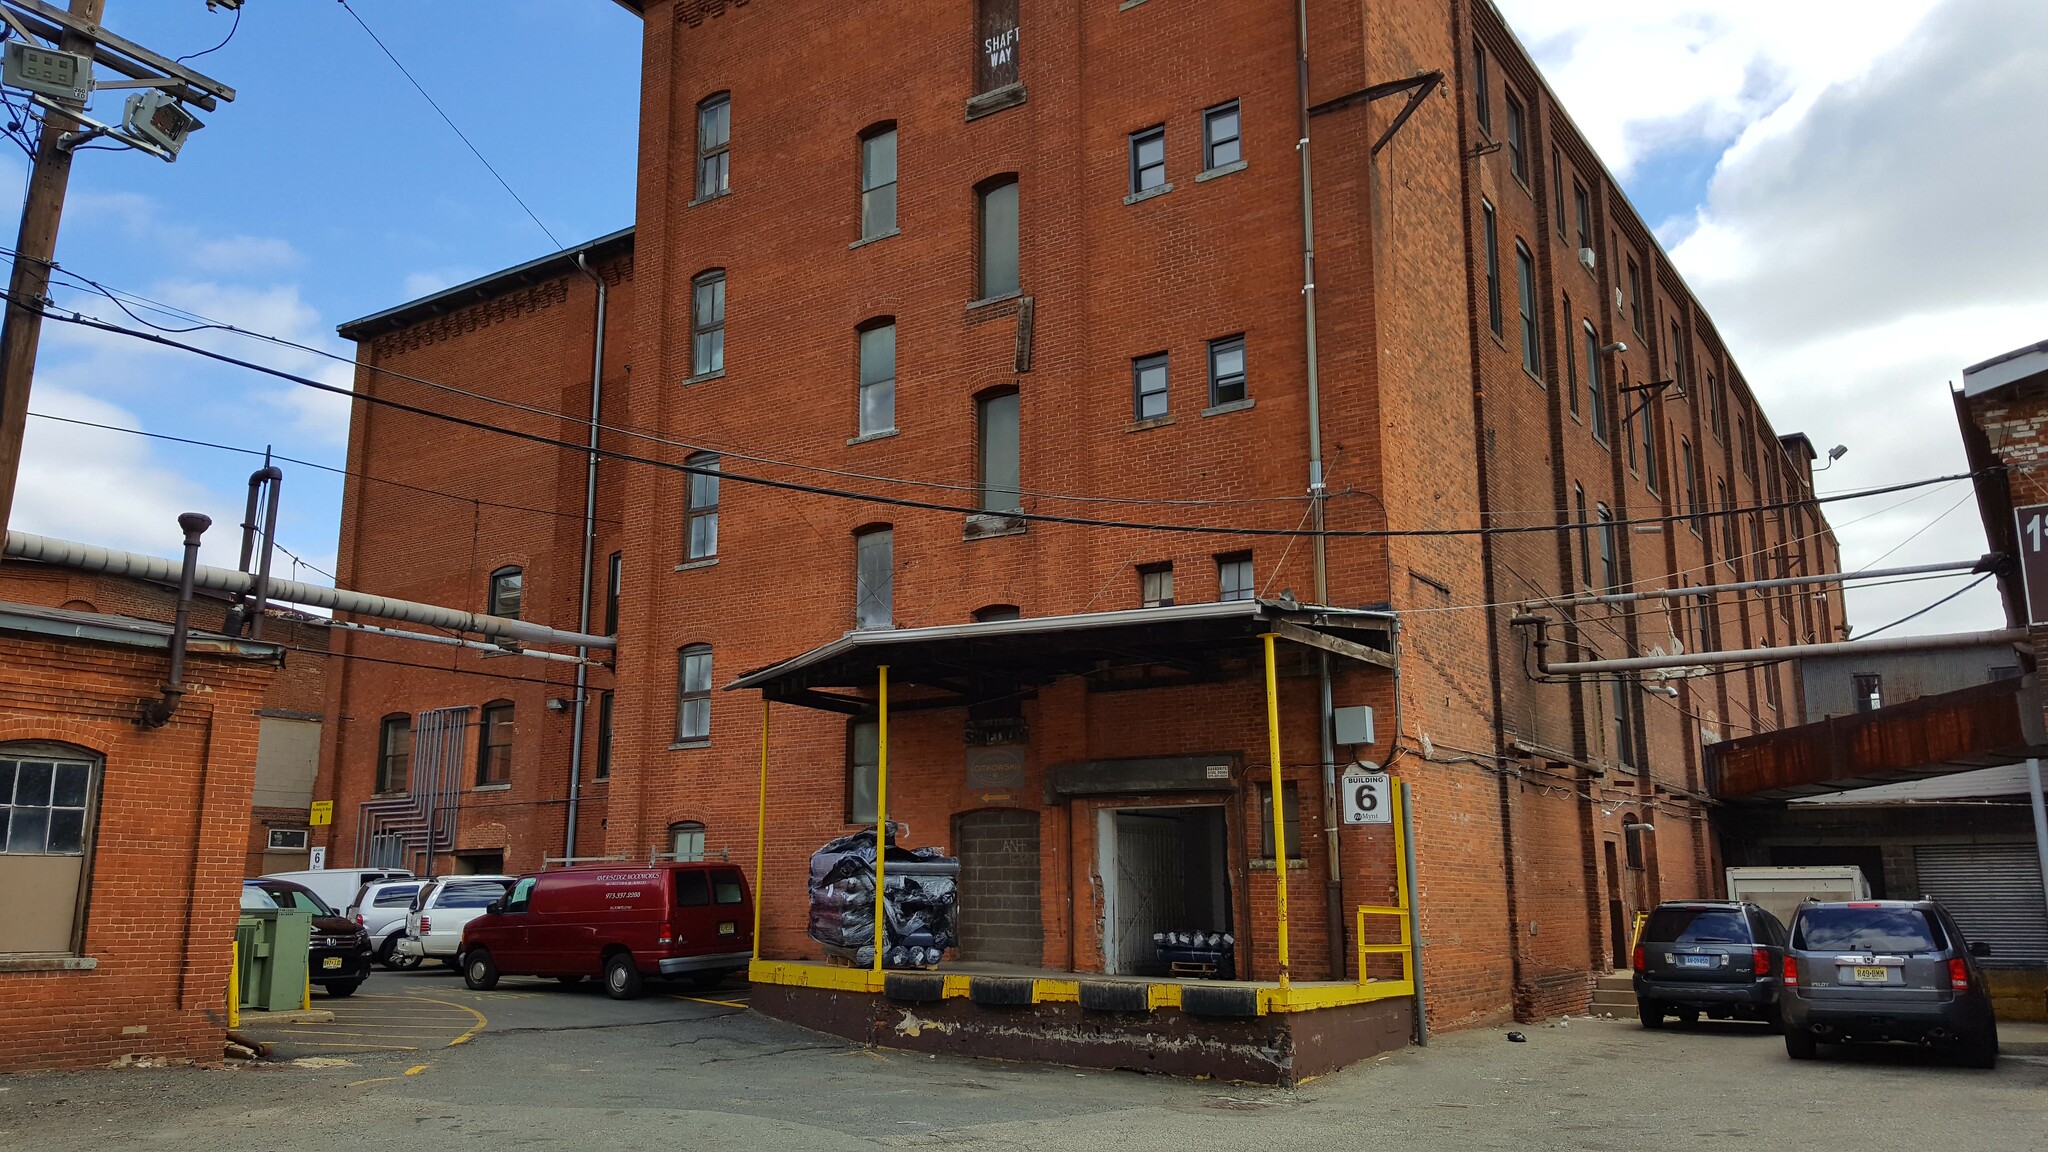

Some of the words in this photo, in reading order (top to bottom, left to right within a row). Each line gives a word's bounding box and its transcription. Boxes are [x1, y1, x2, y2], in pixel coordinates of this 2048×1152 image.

[985, 26, 1020, 54] SHAFT
[990, 46, 1012, 67] WAY
[1355, 784, 1378, 811] 6
[314, 852, 320, 863] 6
